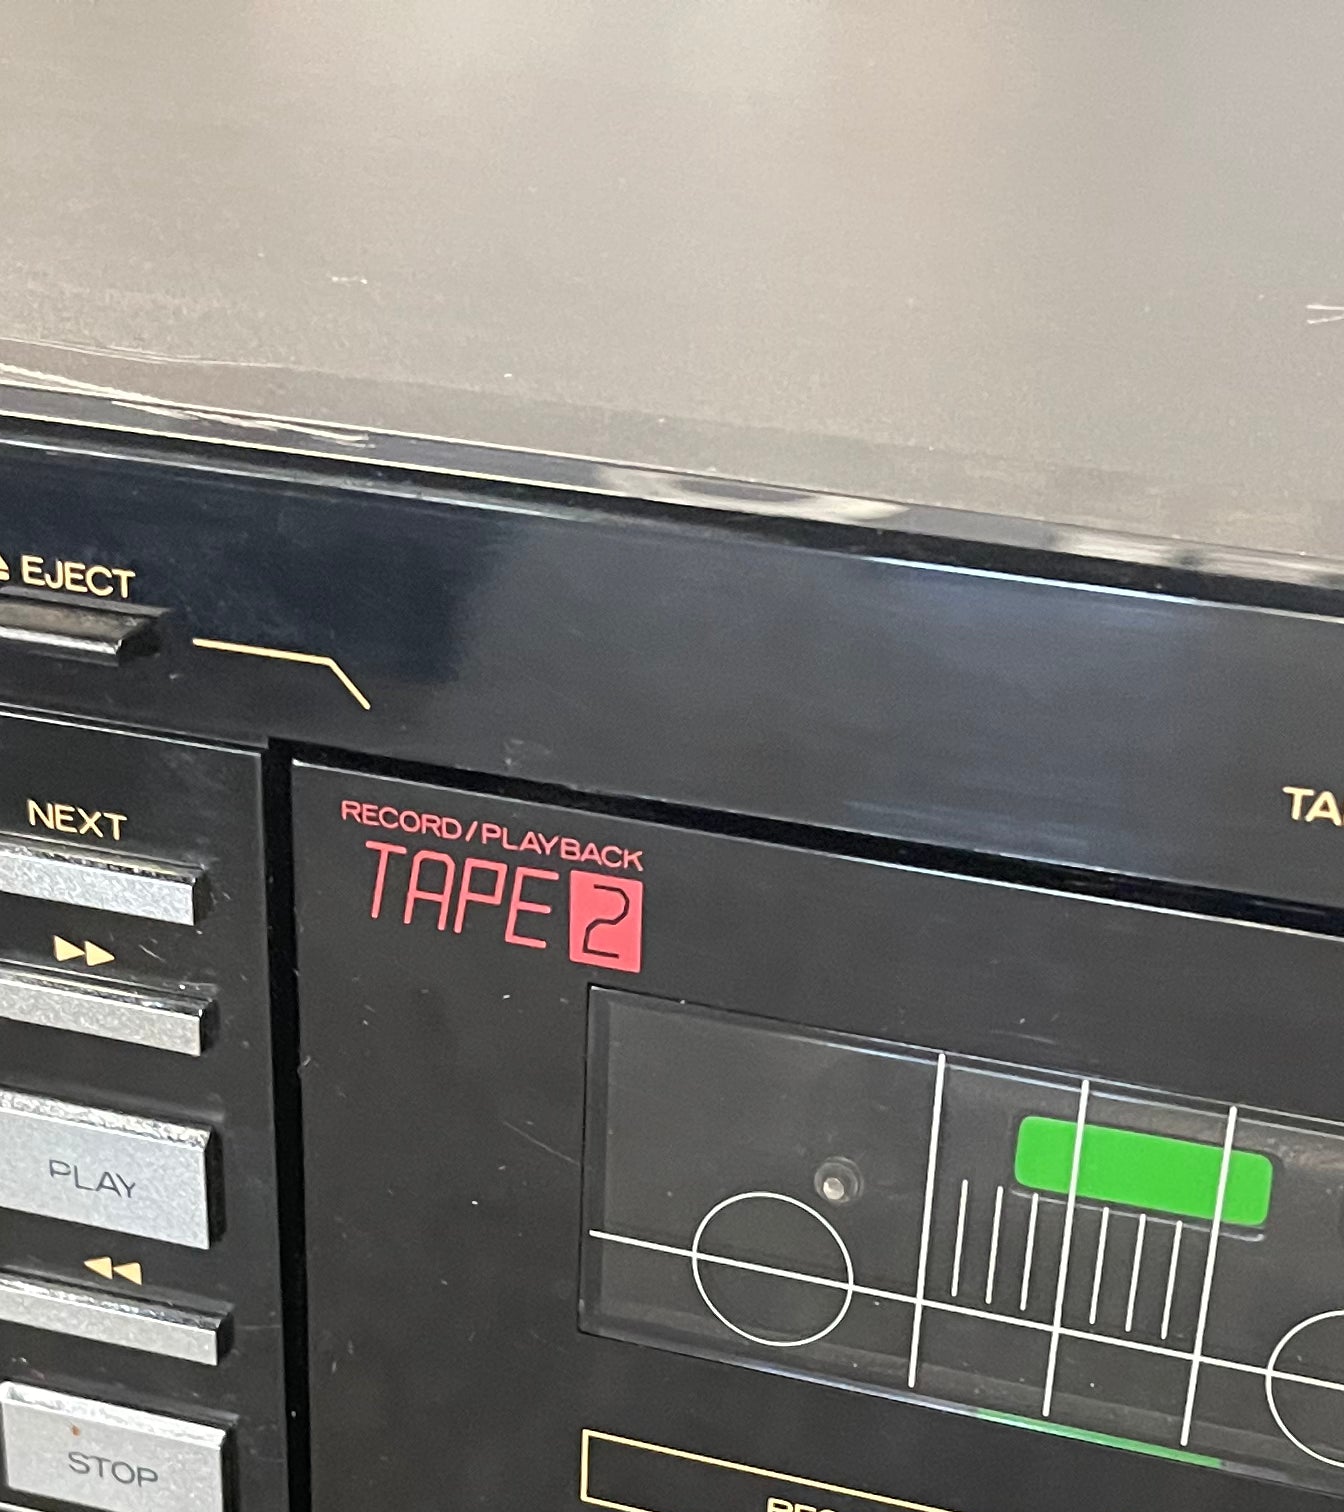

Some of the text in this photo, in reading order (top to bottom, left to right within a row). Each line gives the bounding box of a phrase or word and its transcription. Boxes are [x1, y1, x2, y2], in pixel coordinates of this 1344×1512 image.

[20, 554, 136, 599] EJECT
[26, 798, 128, 841] NEXT
[341, 800, 644, 873] RECORD/PLAYBACK
[364, 840, 634, 963] TAPE 2
[48, 1158, 137, 1199] PLAY
[67, 1451, 159, 1488] STOP
